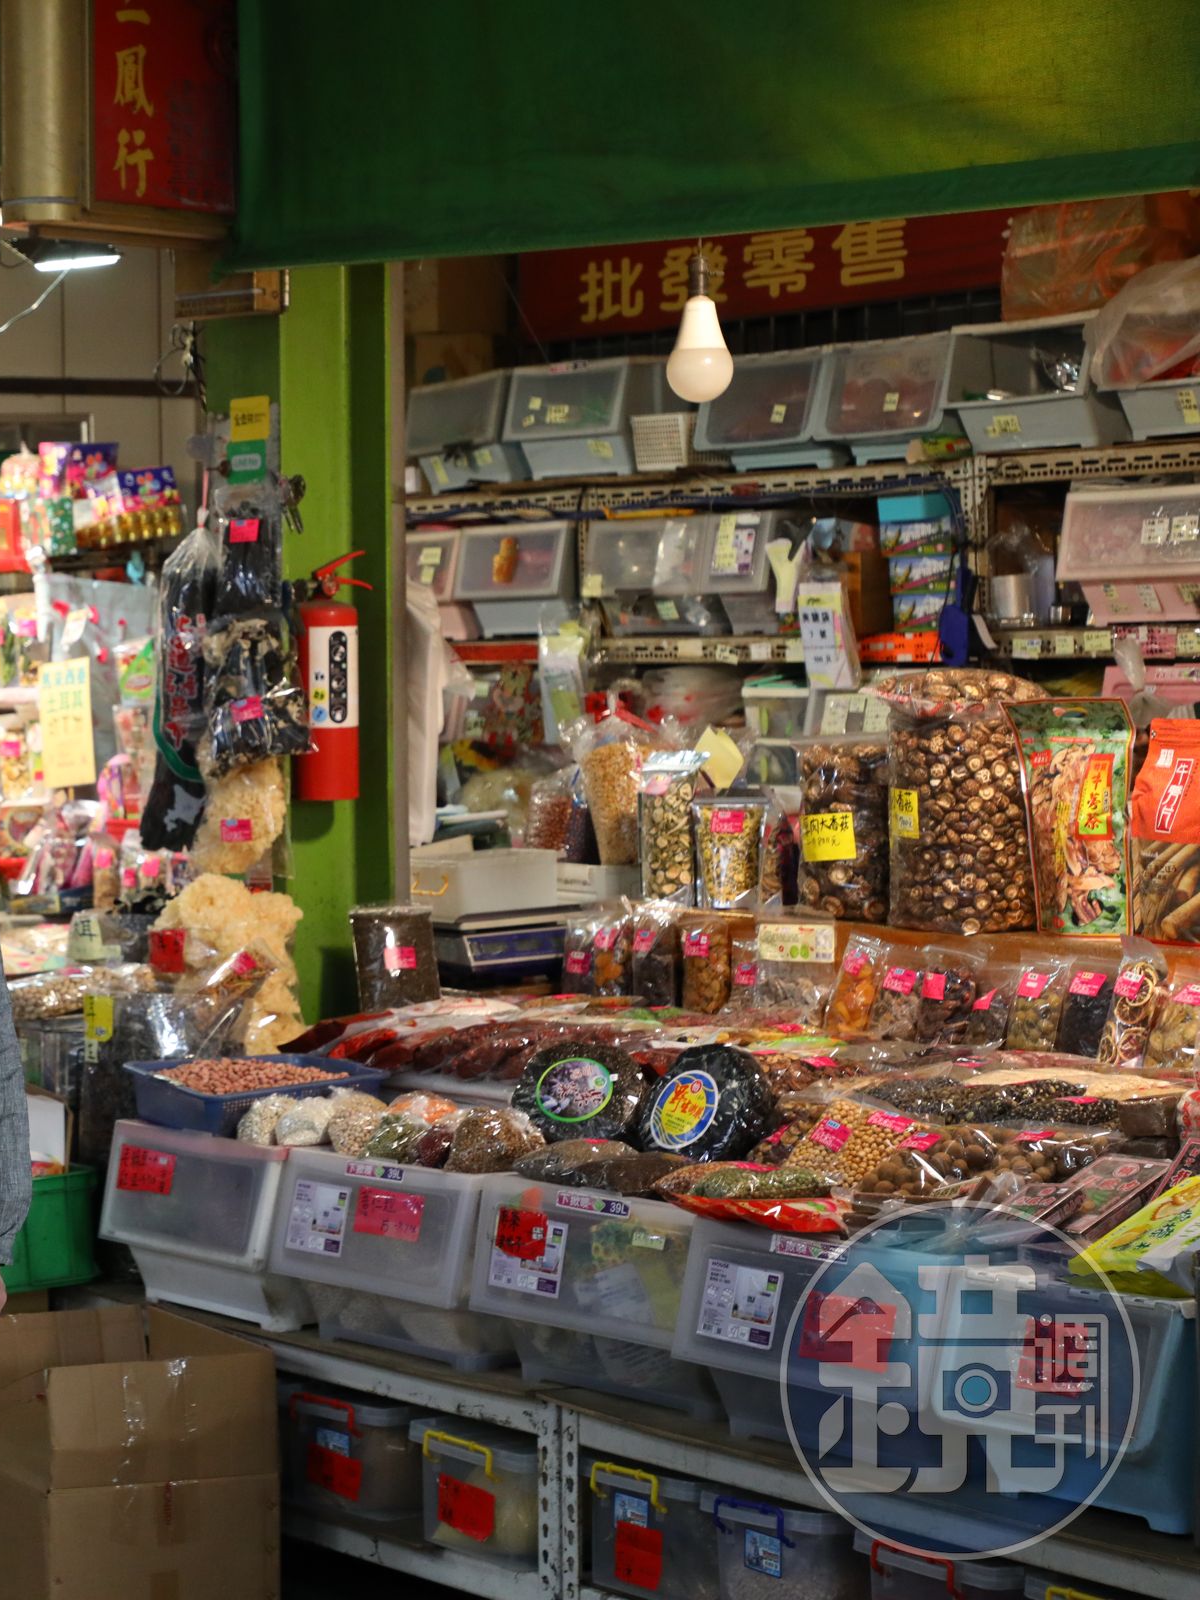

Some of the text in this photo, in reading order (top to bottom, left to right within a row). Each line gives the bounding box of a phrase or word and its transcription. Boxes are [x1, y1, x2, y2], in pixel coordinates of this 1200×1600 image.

[578, 218, 908, 323] 批發零售
[387, 1167, 402, 1180] 39L
[609, 1201, 628, 1215] 39L
